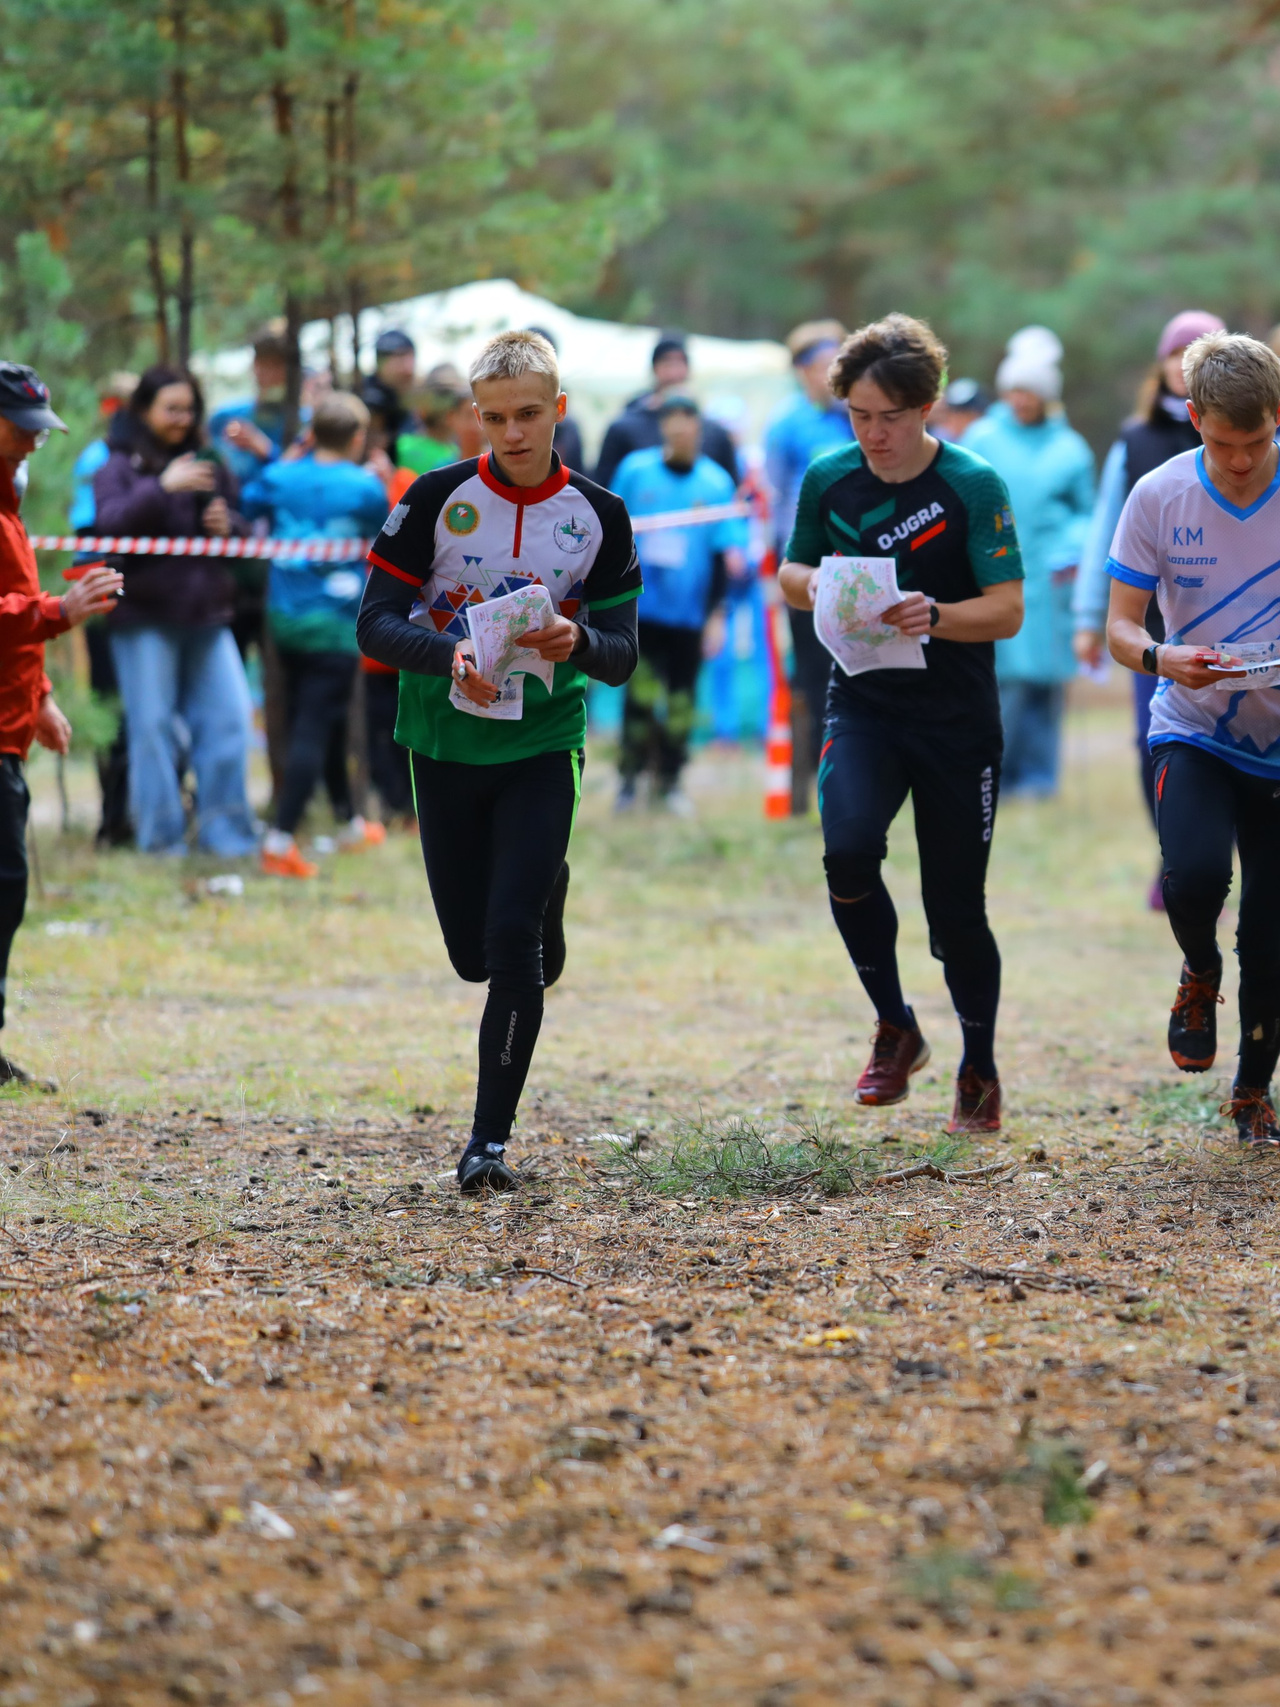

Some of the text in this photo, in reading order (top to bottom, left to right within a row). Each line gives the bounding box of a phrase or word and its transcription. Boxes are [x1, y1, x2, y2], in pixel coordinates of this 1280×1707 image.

[877, 501, 945, 550] O-UGRA
[1173, 526, 1203, 546] KM
[981, 766, 993, 842] O-UGRA
